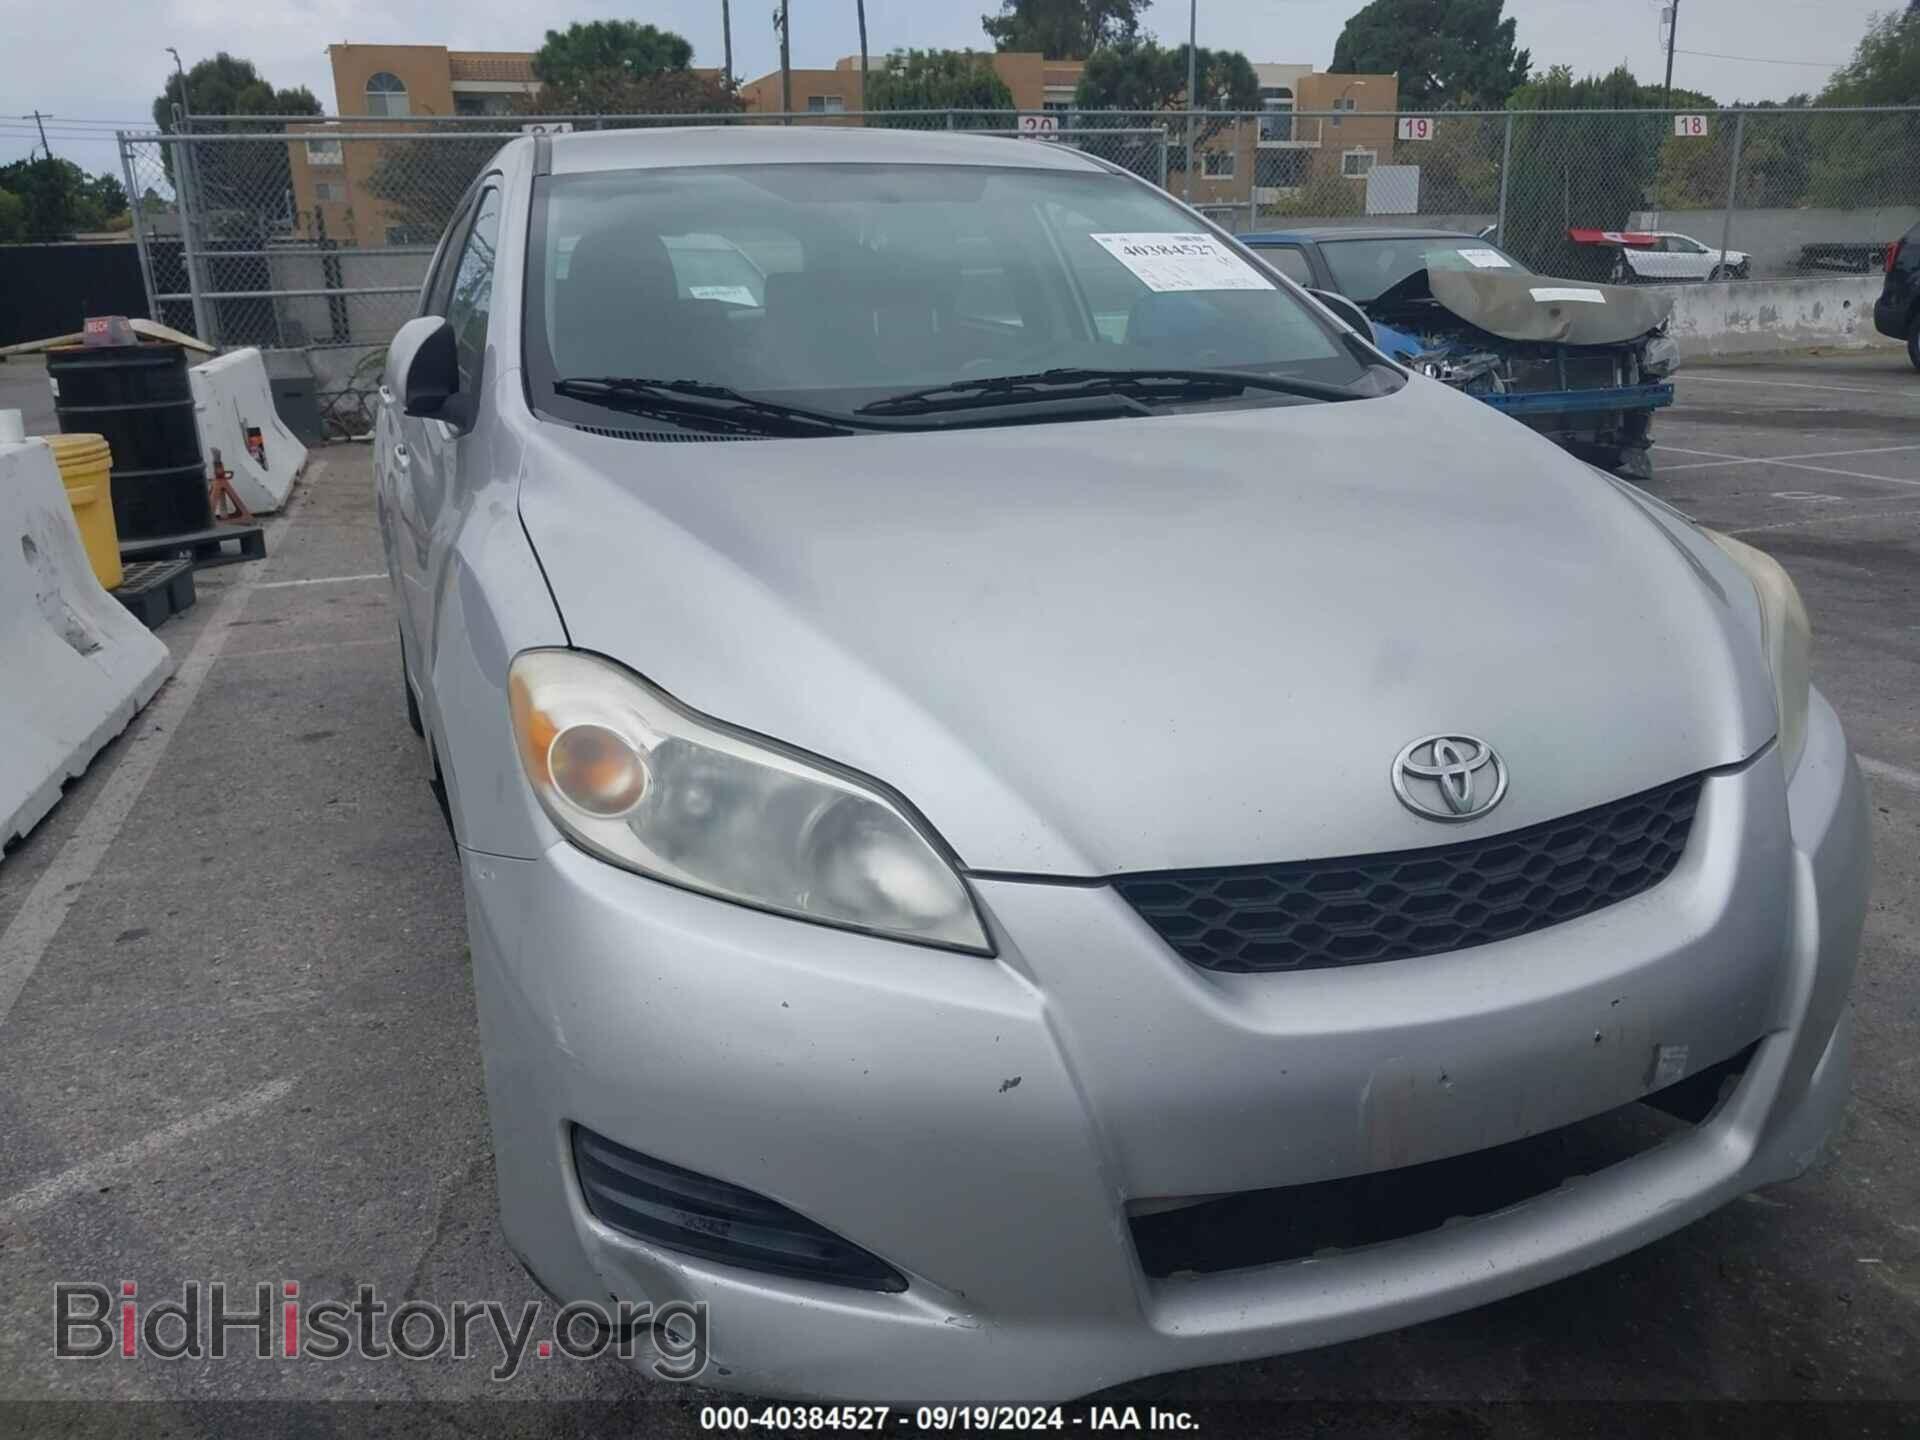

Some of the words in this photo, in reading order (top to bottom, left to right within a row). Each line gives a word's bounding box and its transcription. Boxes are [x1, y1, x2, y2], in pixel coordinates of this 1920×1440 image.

[1025, 118, 1052, 139] 20
[1406, 119, 1427, 138] 19
[1681, 117, 1702, 134] 18
[1123, 244, 1217, 256] 40384527
